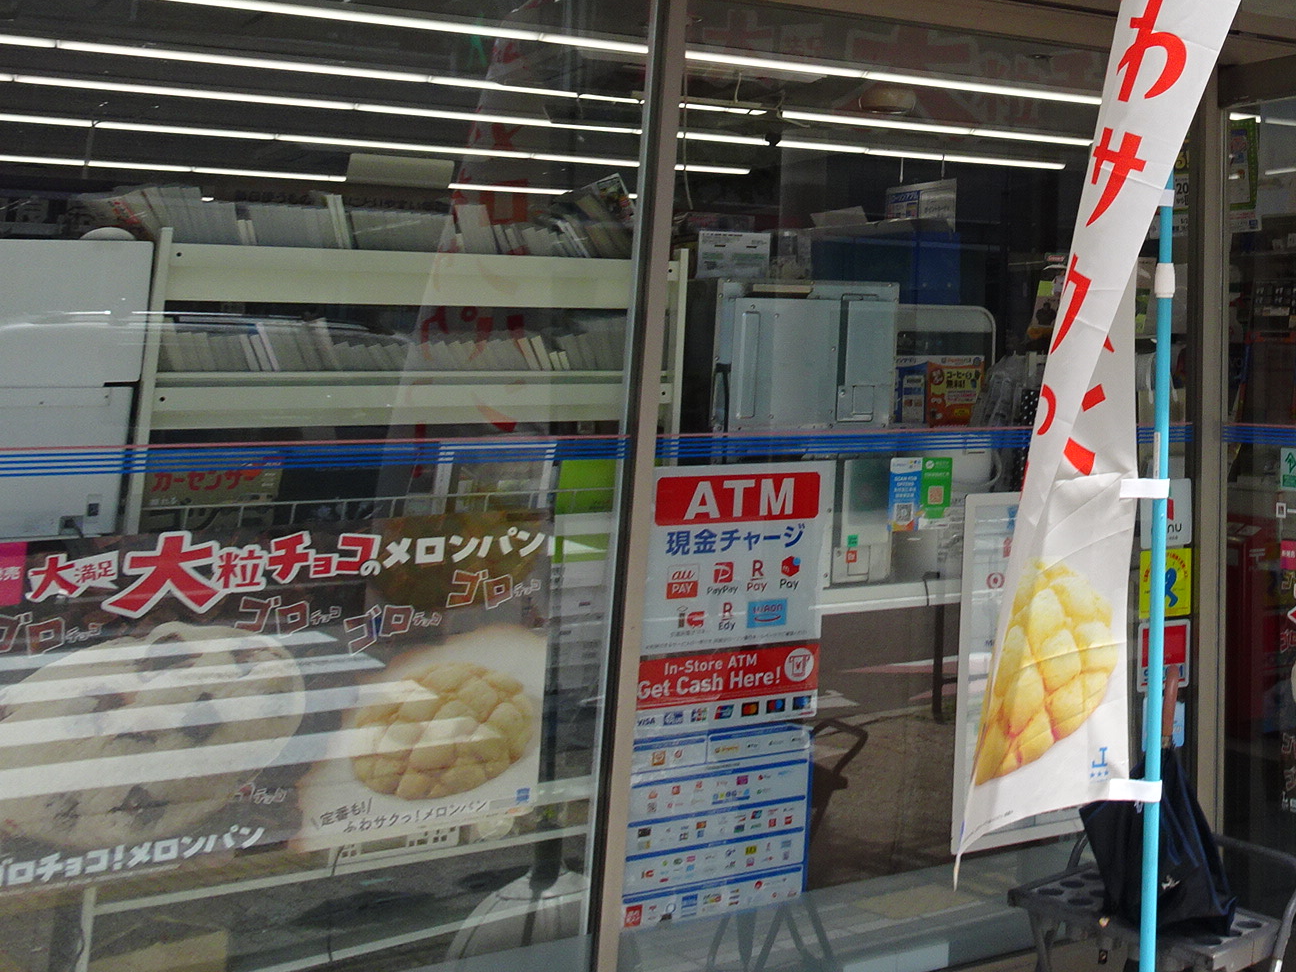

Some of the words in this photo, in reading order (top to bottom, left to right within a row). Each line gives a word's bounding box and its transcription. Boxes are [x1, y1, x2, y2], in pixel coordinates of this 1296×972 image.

[683, 477, 795, 521] ATM
[665, 523, 806, 557] 現金チャージ
[26, 551, 118, 604] 大満足
[671, 582, 694, 595] PAY
[706, 584, 739, 597] PayPay
[779, 579, 800, 591] Pay
[718, 620, 737, 632] Edy
[664, 658, 723, 676] In-Store
[728, 653, 758, 670] ATM
[637, 680, 671, 700] Get
[676, 672, 724, 695] Cash
[729, 665, 782, 691] Here!
